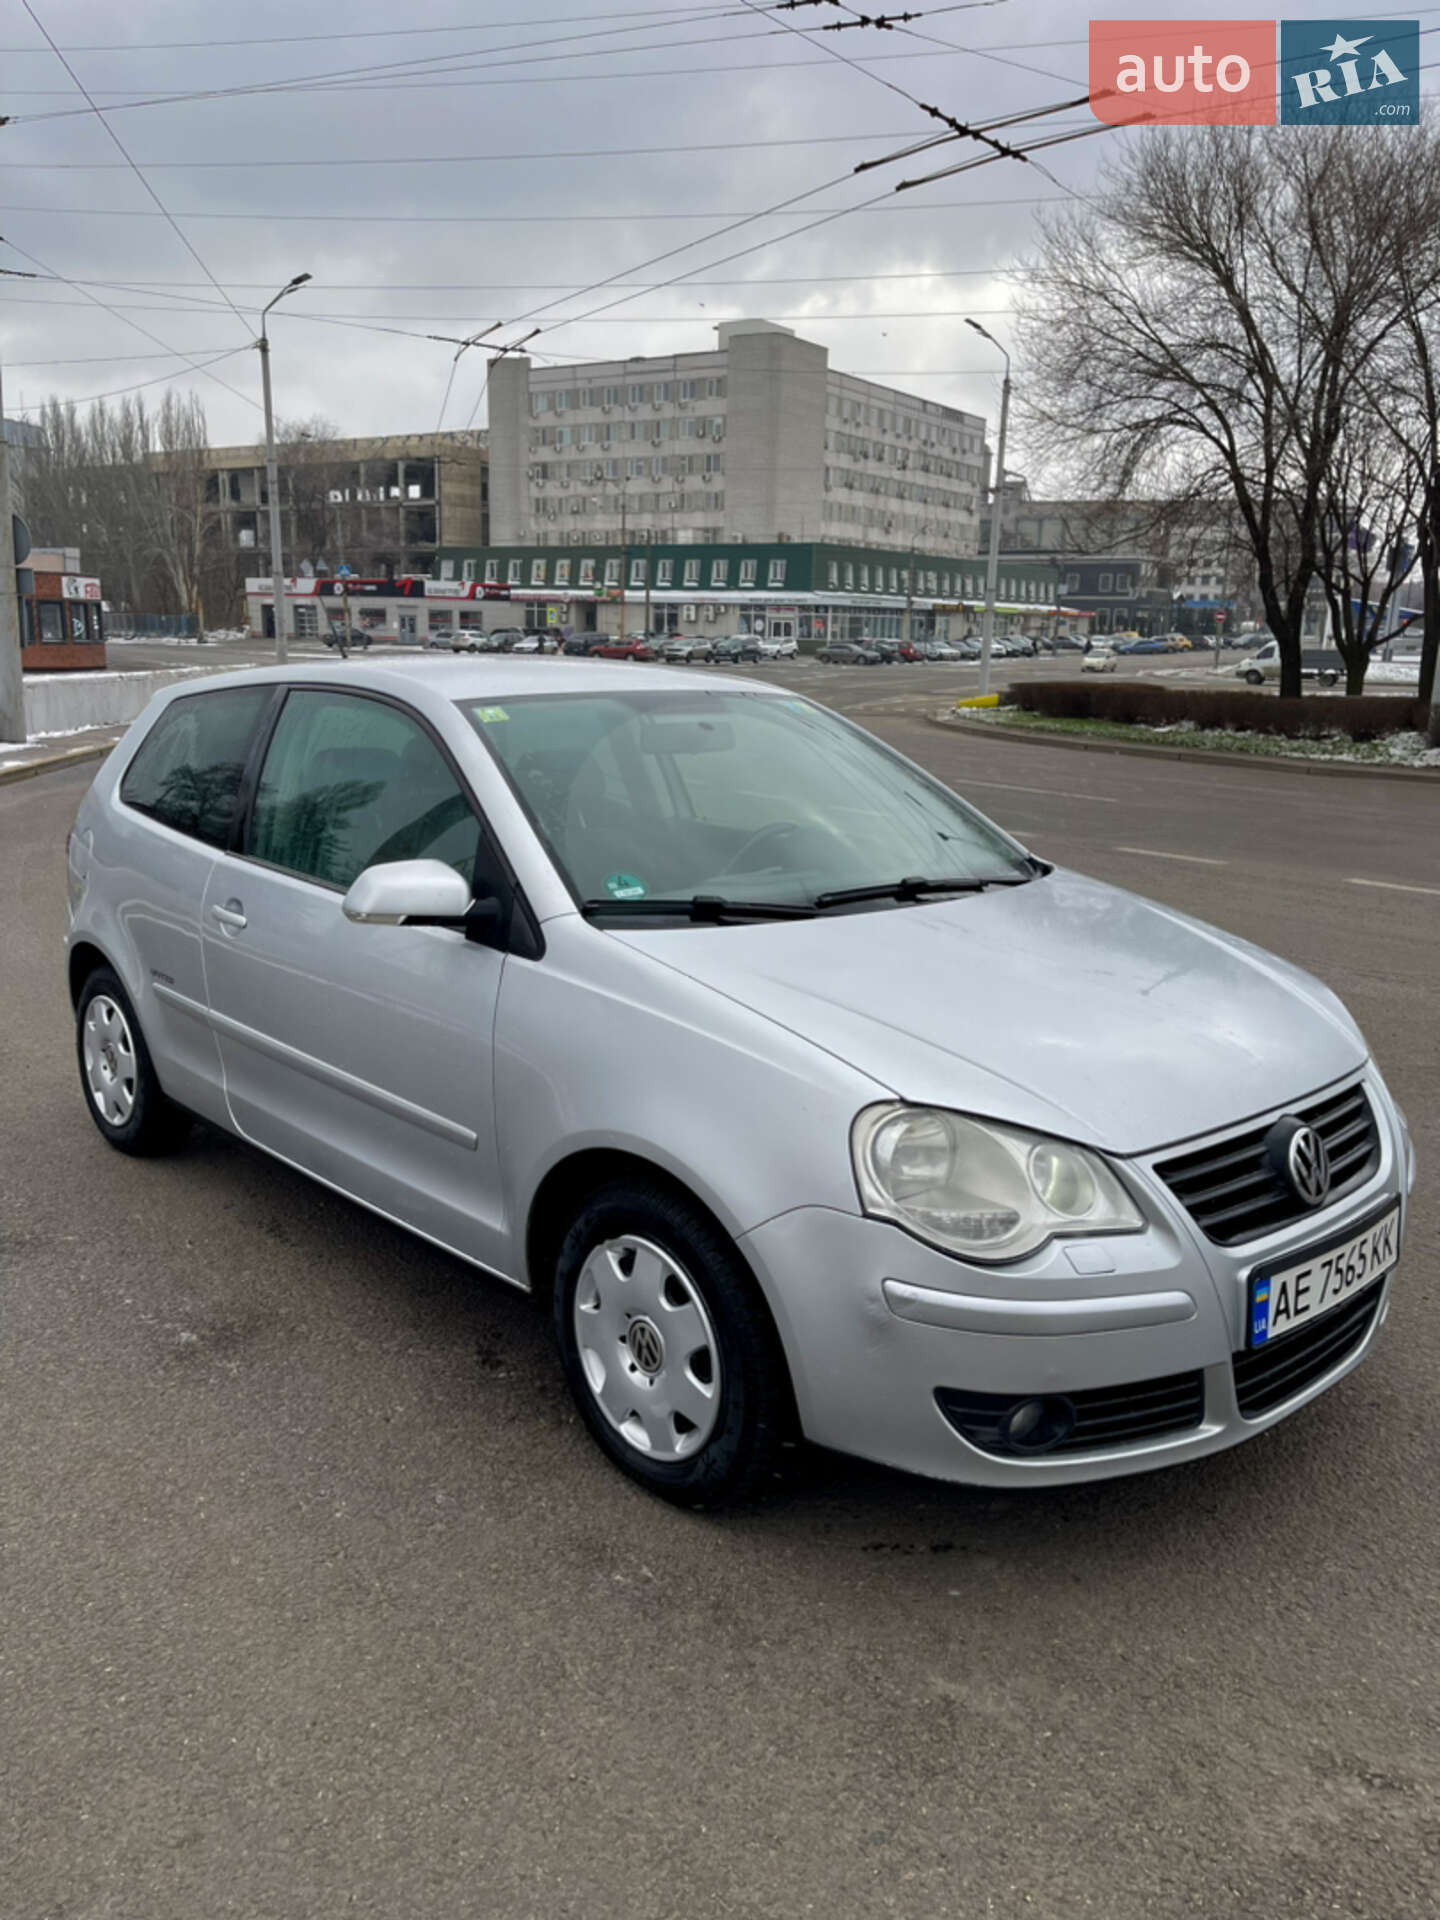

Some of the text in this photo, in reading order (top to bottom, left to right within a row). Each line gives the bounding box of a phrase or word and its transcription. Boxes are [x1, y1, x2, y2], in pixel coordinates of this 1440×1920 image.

[1273, 1218, 1395, 1327] AE 7565 KK
